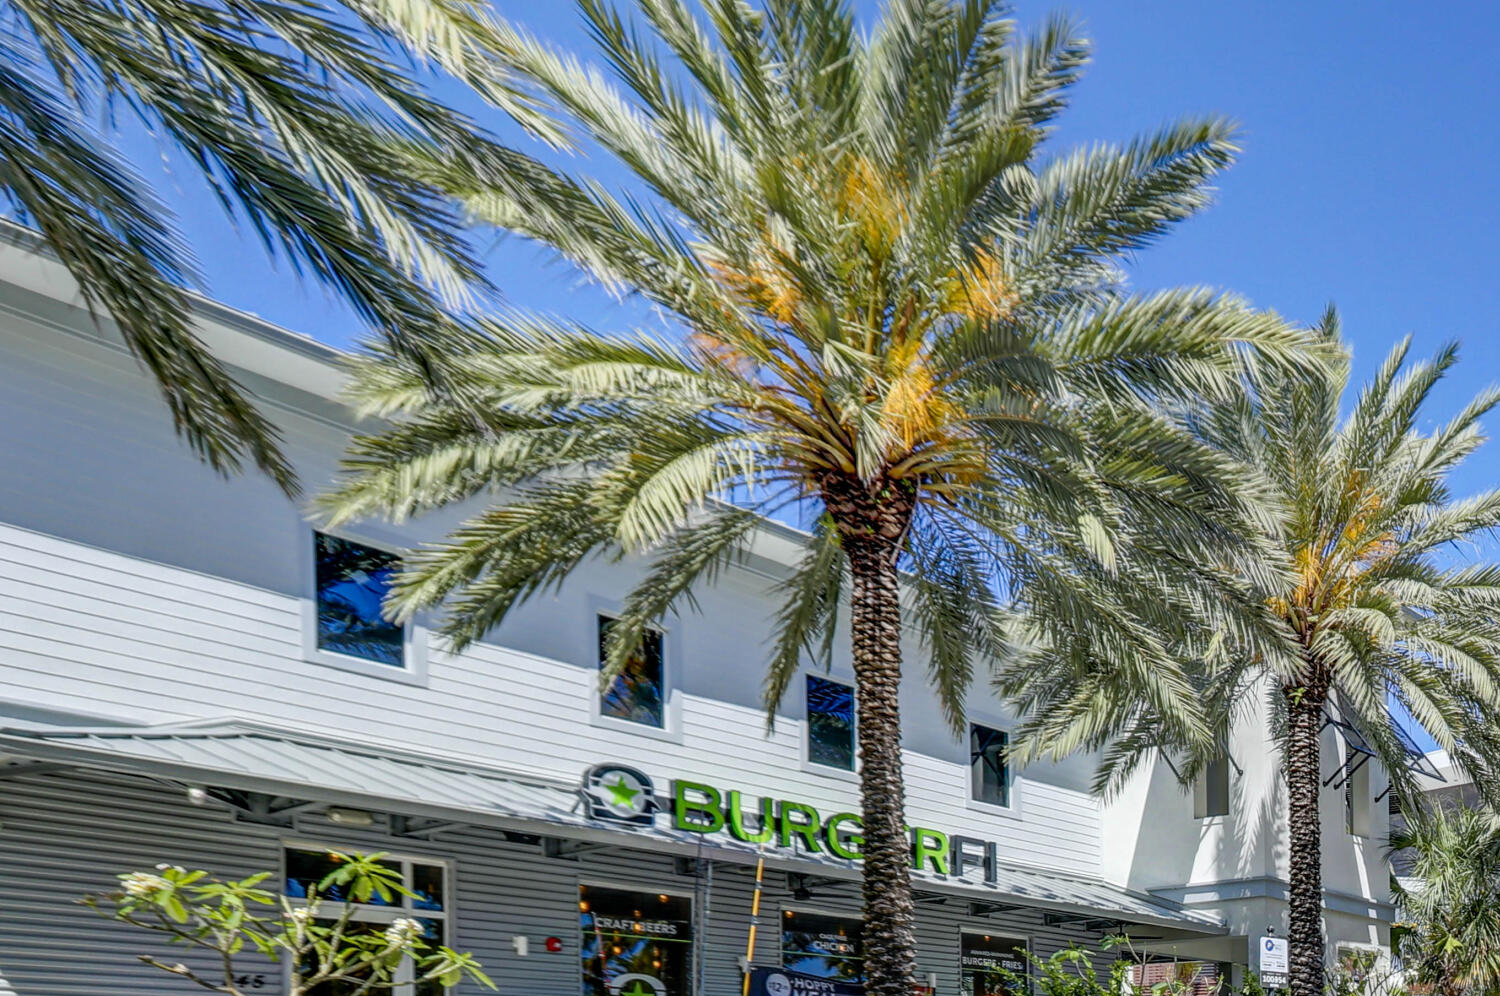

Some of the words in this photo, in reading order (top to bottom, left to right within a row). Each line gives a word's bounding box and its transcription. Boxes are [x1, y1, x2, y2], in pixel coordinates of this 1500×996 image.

[672, 778, 997, 883] BURGRFI
[594, 917, 634, 931] CRAFT
[640, 920, 678, 935] BEERS
[794, 977, 835, 992] HOPPY
